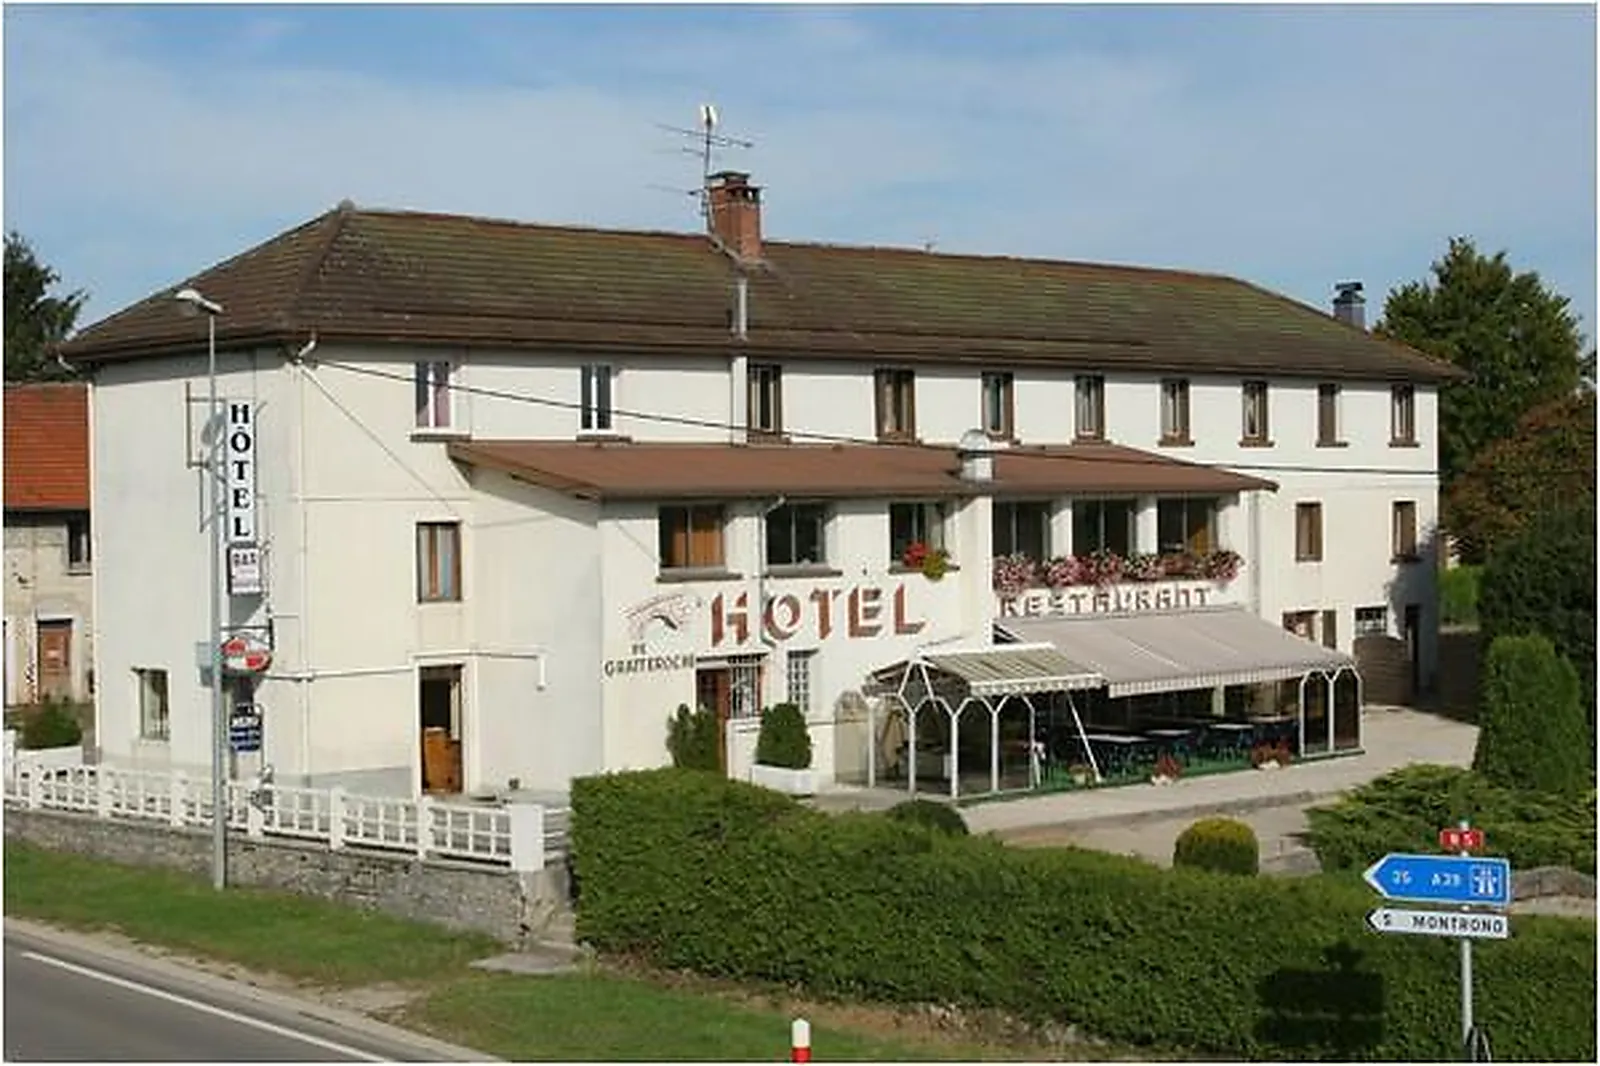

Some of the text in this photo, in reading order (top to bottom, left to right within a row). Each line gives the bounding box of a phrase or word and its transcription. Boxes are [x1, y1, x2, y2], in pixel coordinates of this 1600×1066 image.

[230, 403, 252, 537] HÔTEL
[710, 583, 926, 648] HOTEL
[1001, 587, 1211, 617] RESTAURANT
[1412, 916, 1503, 933] MONTROND
